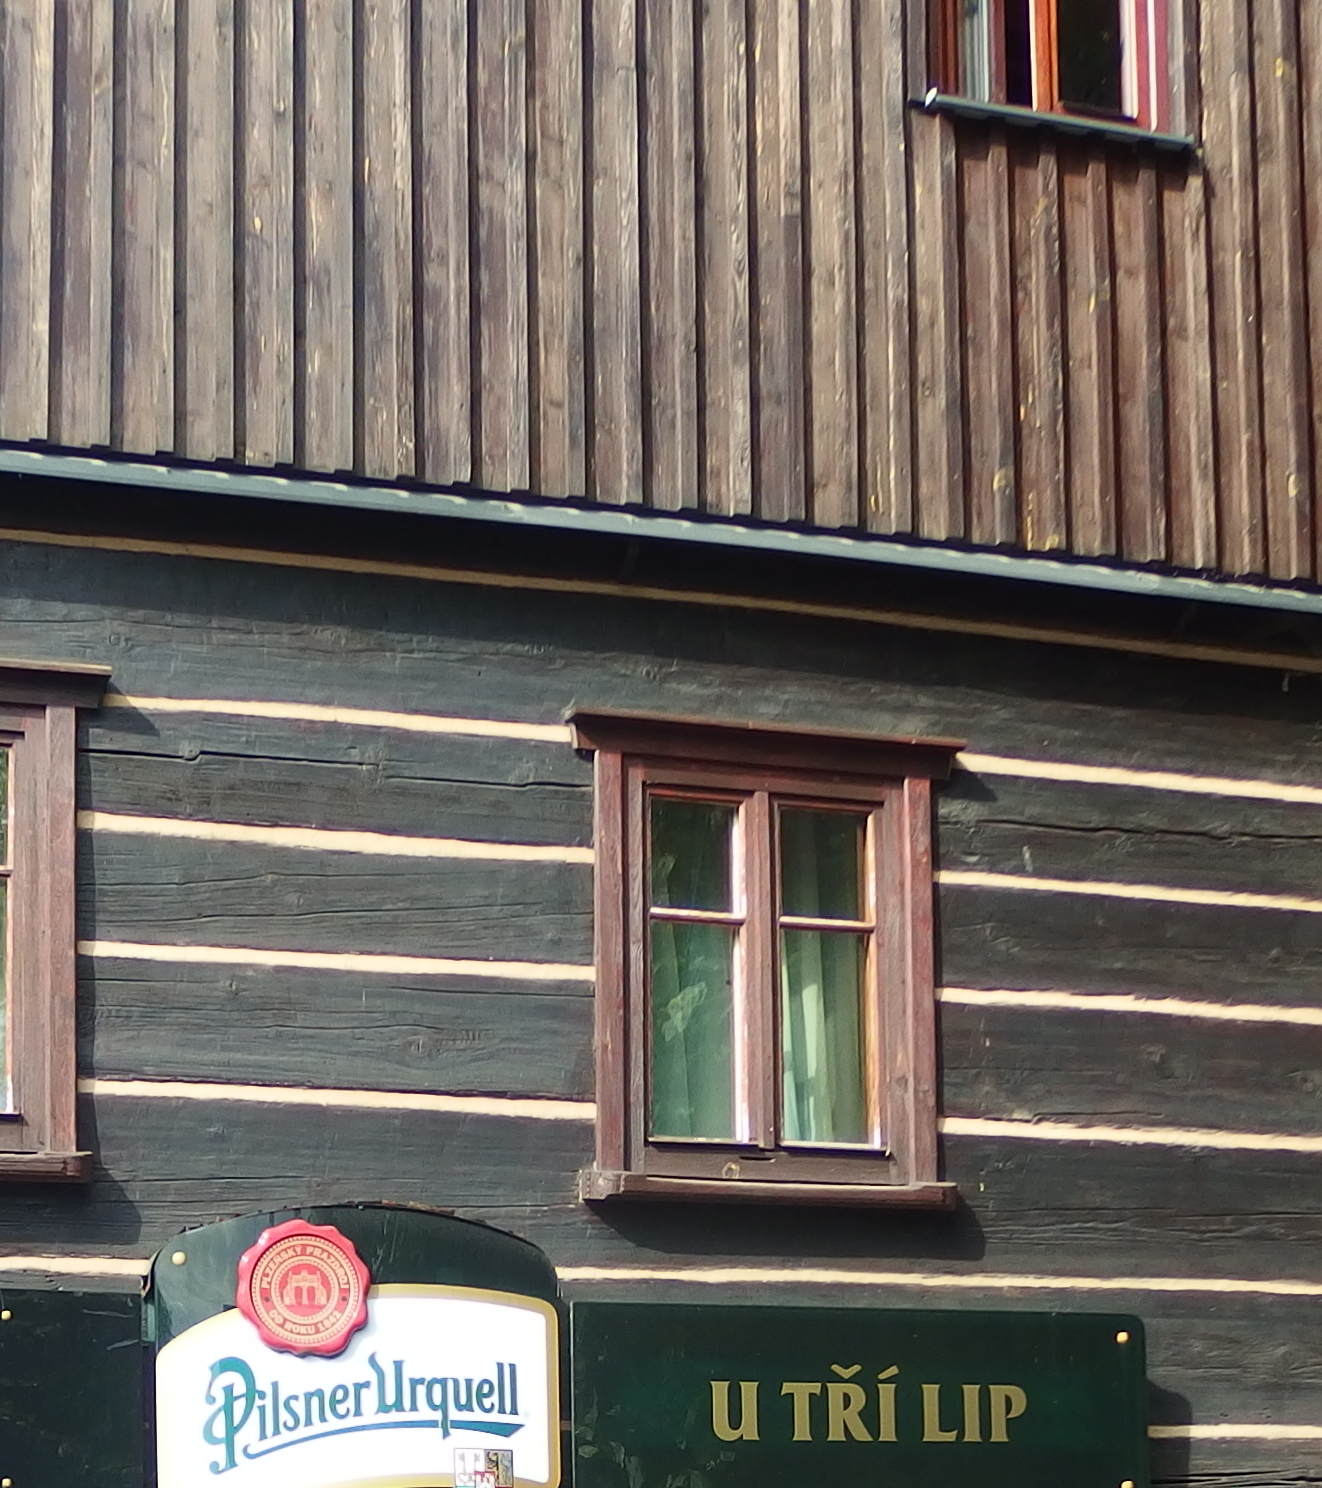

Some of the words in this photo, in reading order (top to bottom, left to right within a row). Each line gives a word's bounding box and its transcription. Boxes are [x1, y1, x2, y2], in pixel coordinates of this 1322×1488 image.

[284, 1322, 316, 1334] ROKU
[202, 1356, 371, 1475] Pilsner
[368, 1351, 520, 1440] Urquell
[710, 1380, 760, 1442] U
[780, 1364, 900, 1442] TŘÍ
[921, 1383, 1028, 1443] LIP
